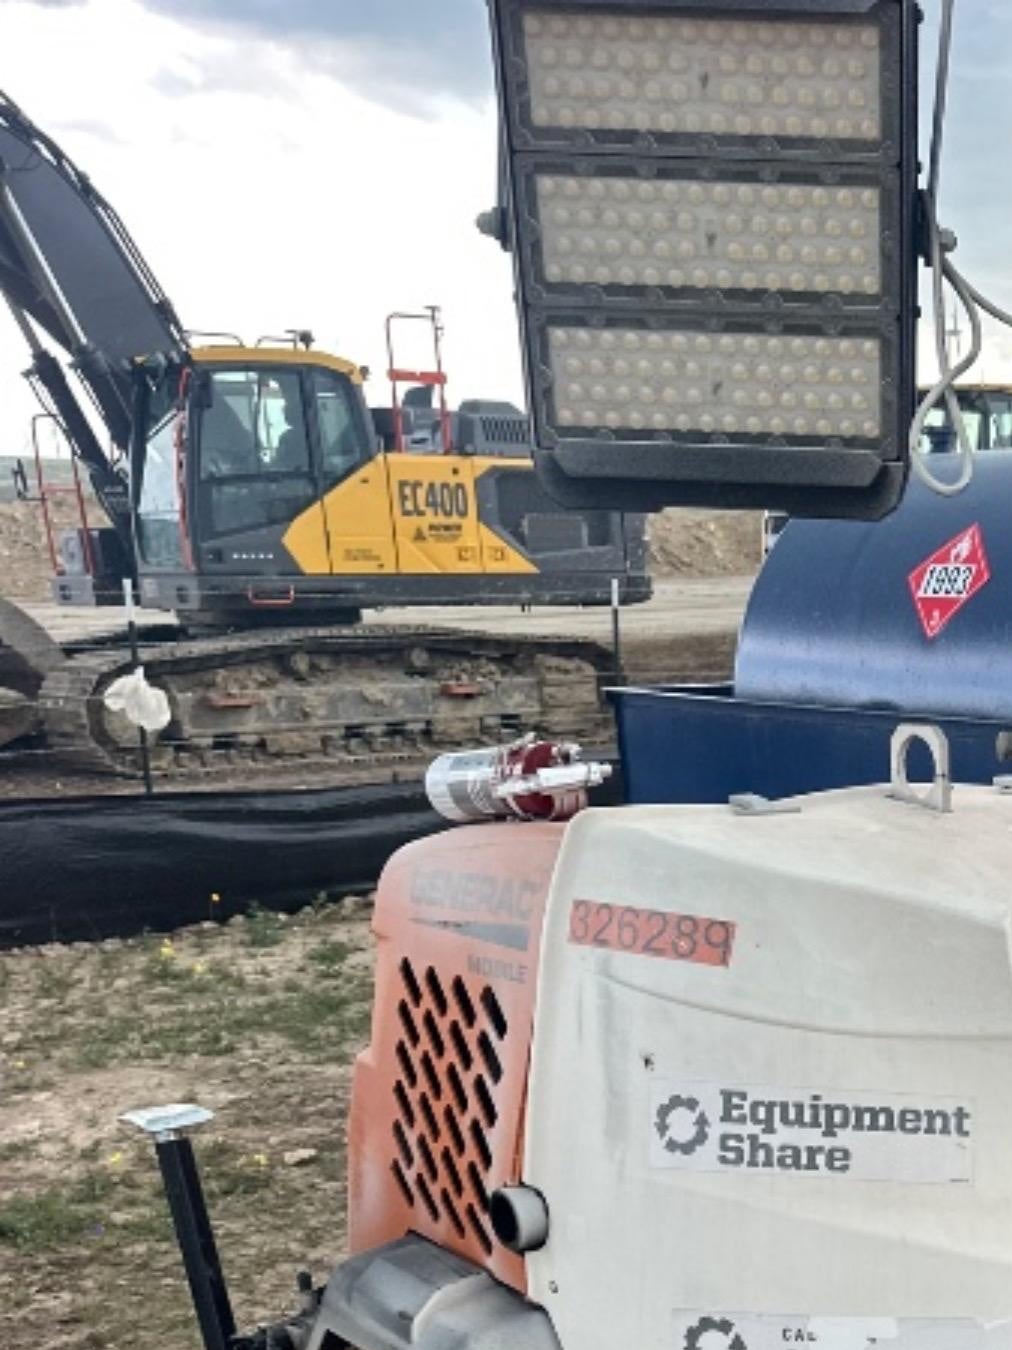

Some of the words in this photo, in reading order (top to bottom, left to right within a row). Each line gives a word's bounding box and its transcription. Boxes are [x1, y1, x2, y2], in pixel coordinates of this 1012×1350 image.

[398, 480, 468, 519] EC400
[923, 565, 973, 595] 1993
[571, 899, 734, 967] 326289
[718, 1088, 971, 1138] Equipment
[717, 1132, 851, 1173] Share
